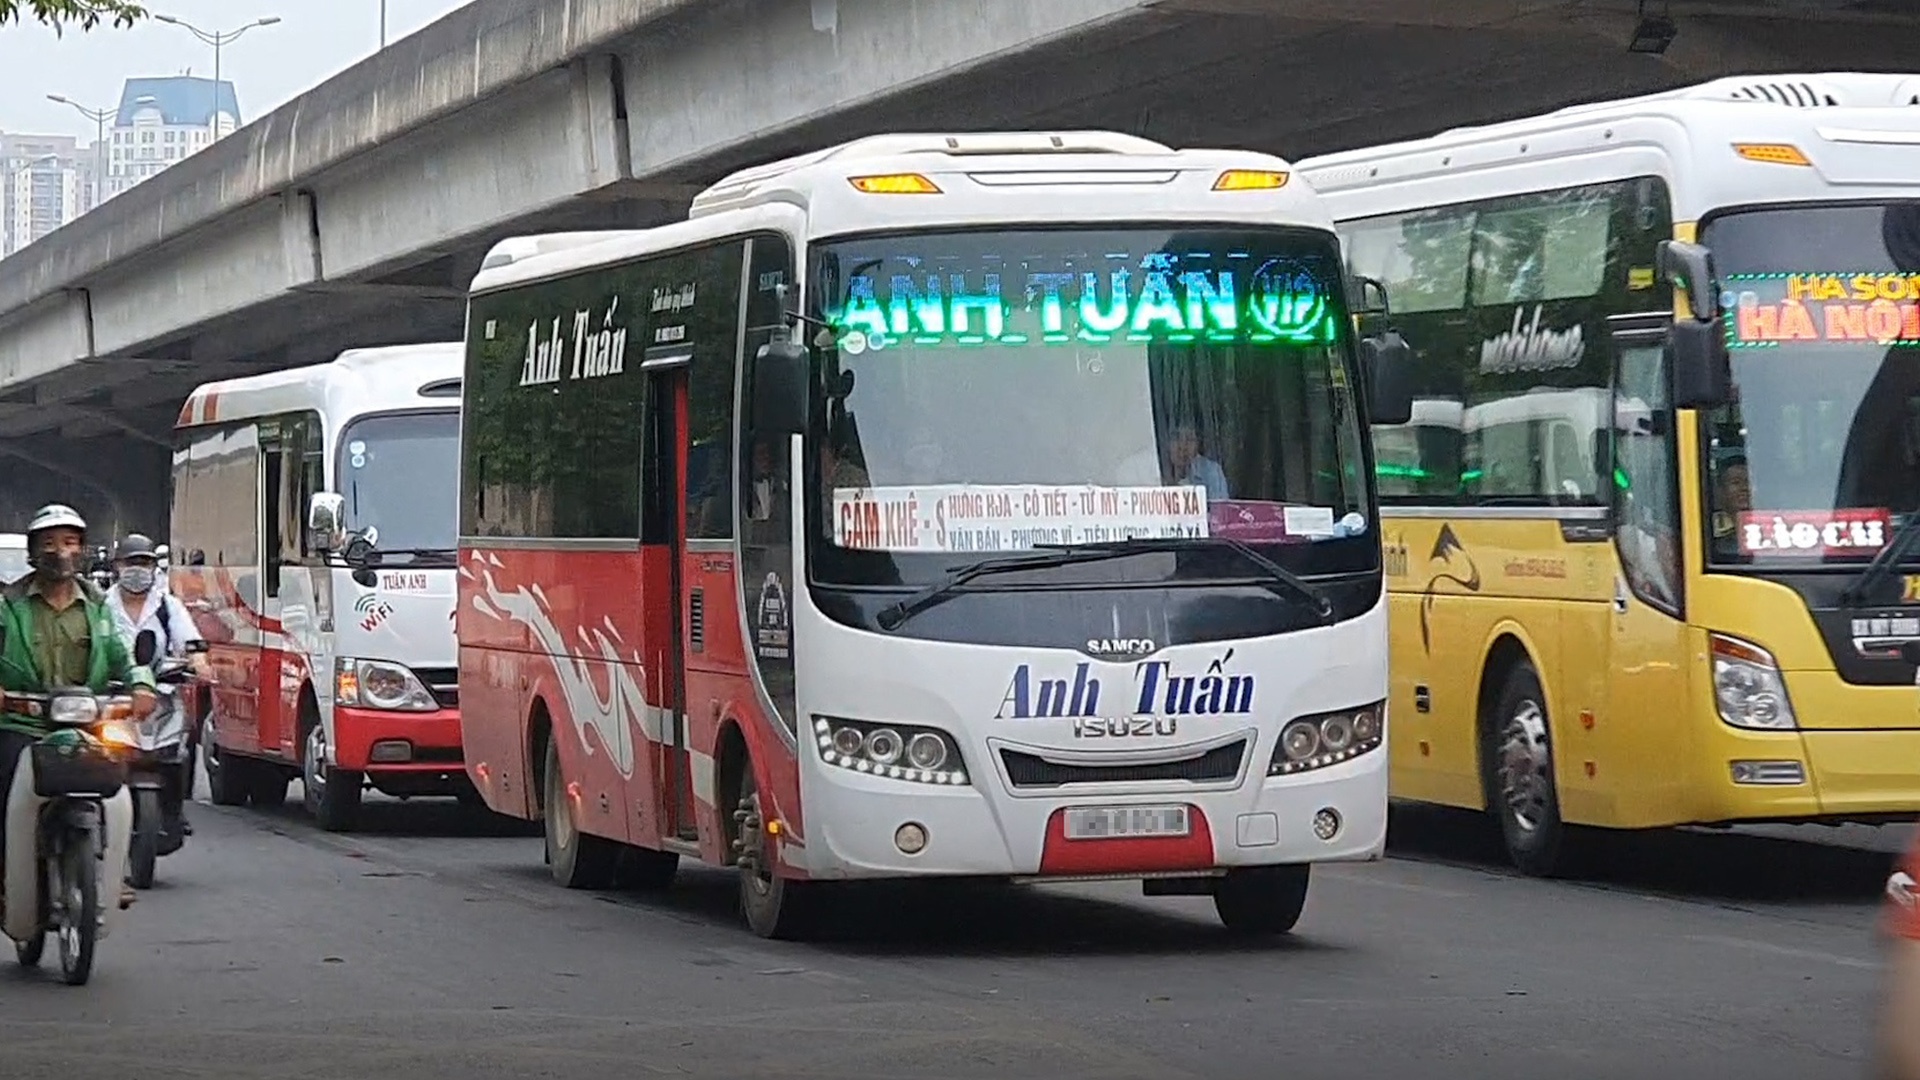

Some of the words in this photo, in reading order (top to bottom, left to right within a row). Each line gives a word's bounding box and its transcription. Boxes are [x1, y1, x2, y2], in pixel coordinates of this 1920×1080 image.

[843, 273, 1003, 334] ANH
[1739, 299, 1818, 340] HÀ
[520, 316, 564, 387] Anh
[570, 295, 627, 380] Tuấn
[885, 491, 919, 547] KHÊ
[1087, 639, 1155, 654] SAMCO
[994, 663, 1101, 719] Anh
[1133, 648, 1255, 716] Tuấn
[1073, 717, 1177, 739] ISUZU
